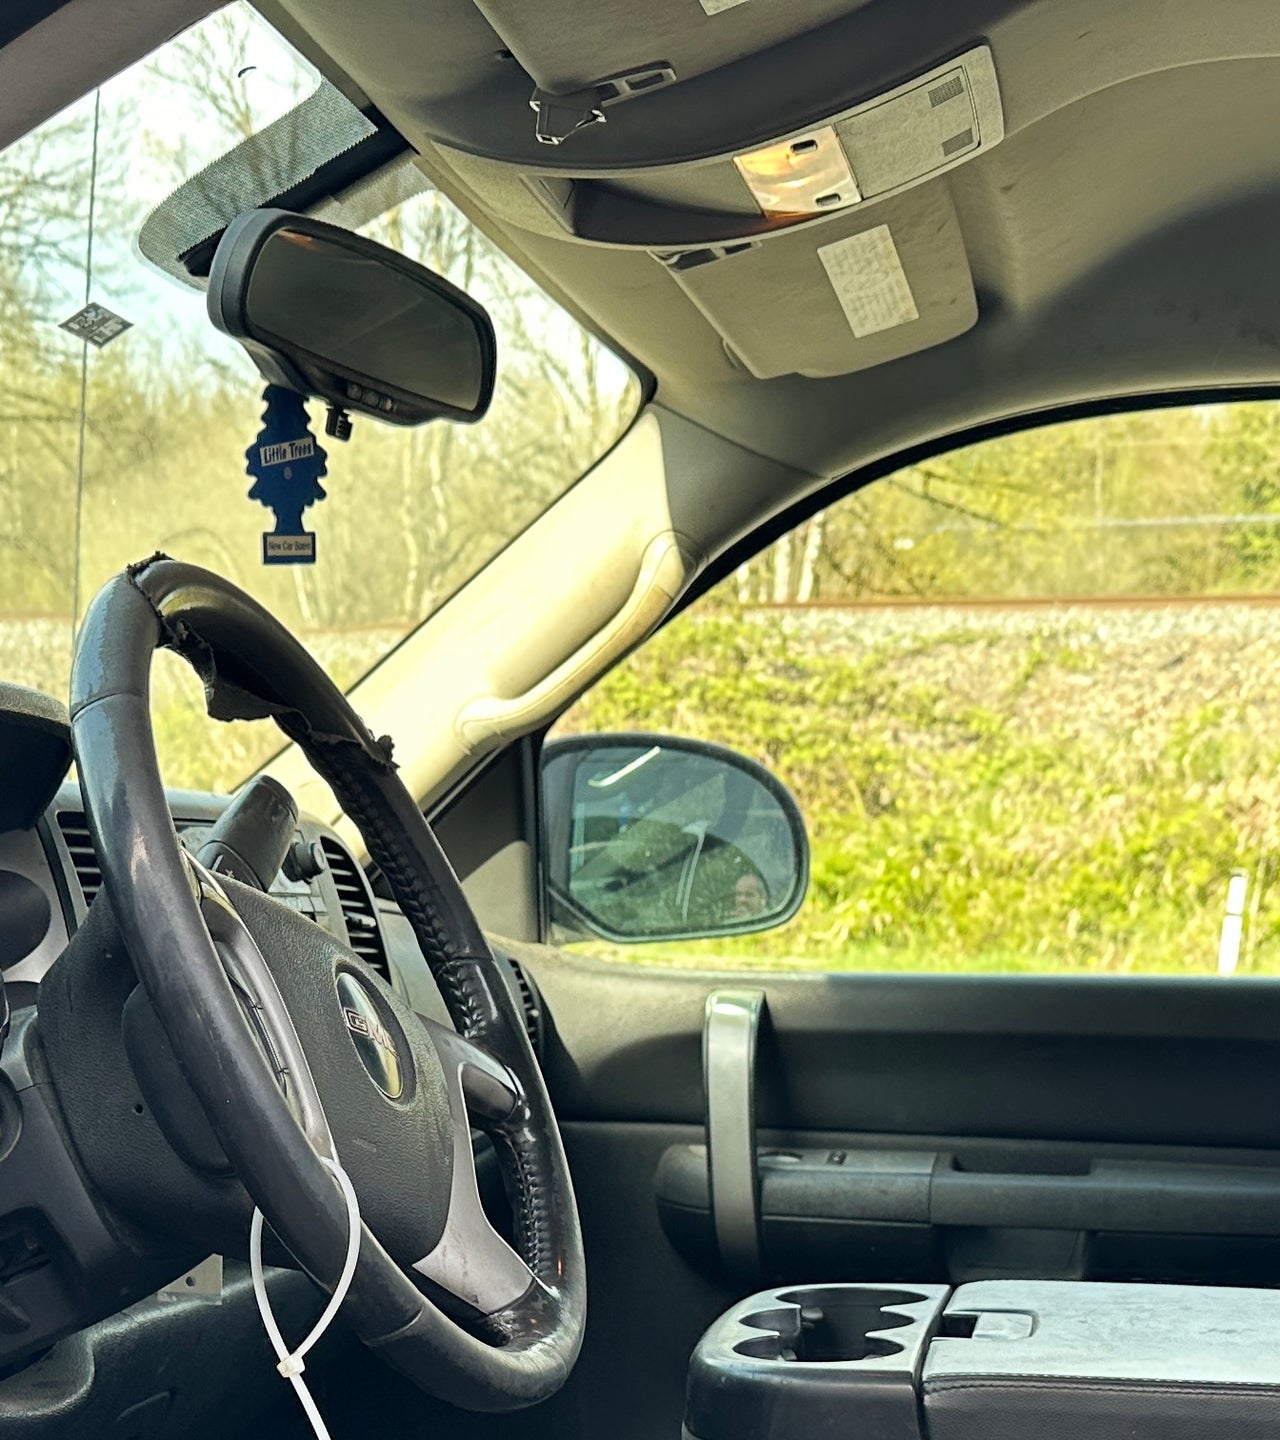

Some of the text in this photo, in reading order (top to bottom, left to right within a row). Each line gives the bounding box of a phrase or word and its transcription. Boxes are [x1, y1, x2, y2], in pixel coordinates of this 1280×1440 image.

[264, 442, 312, 464] Little Trees
[269, 541, 280, 550] New
[282, 541, 293, 550] Car
